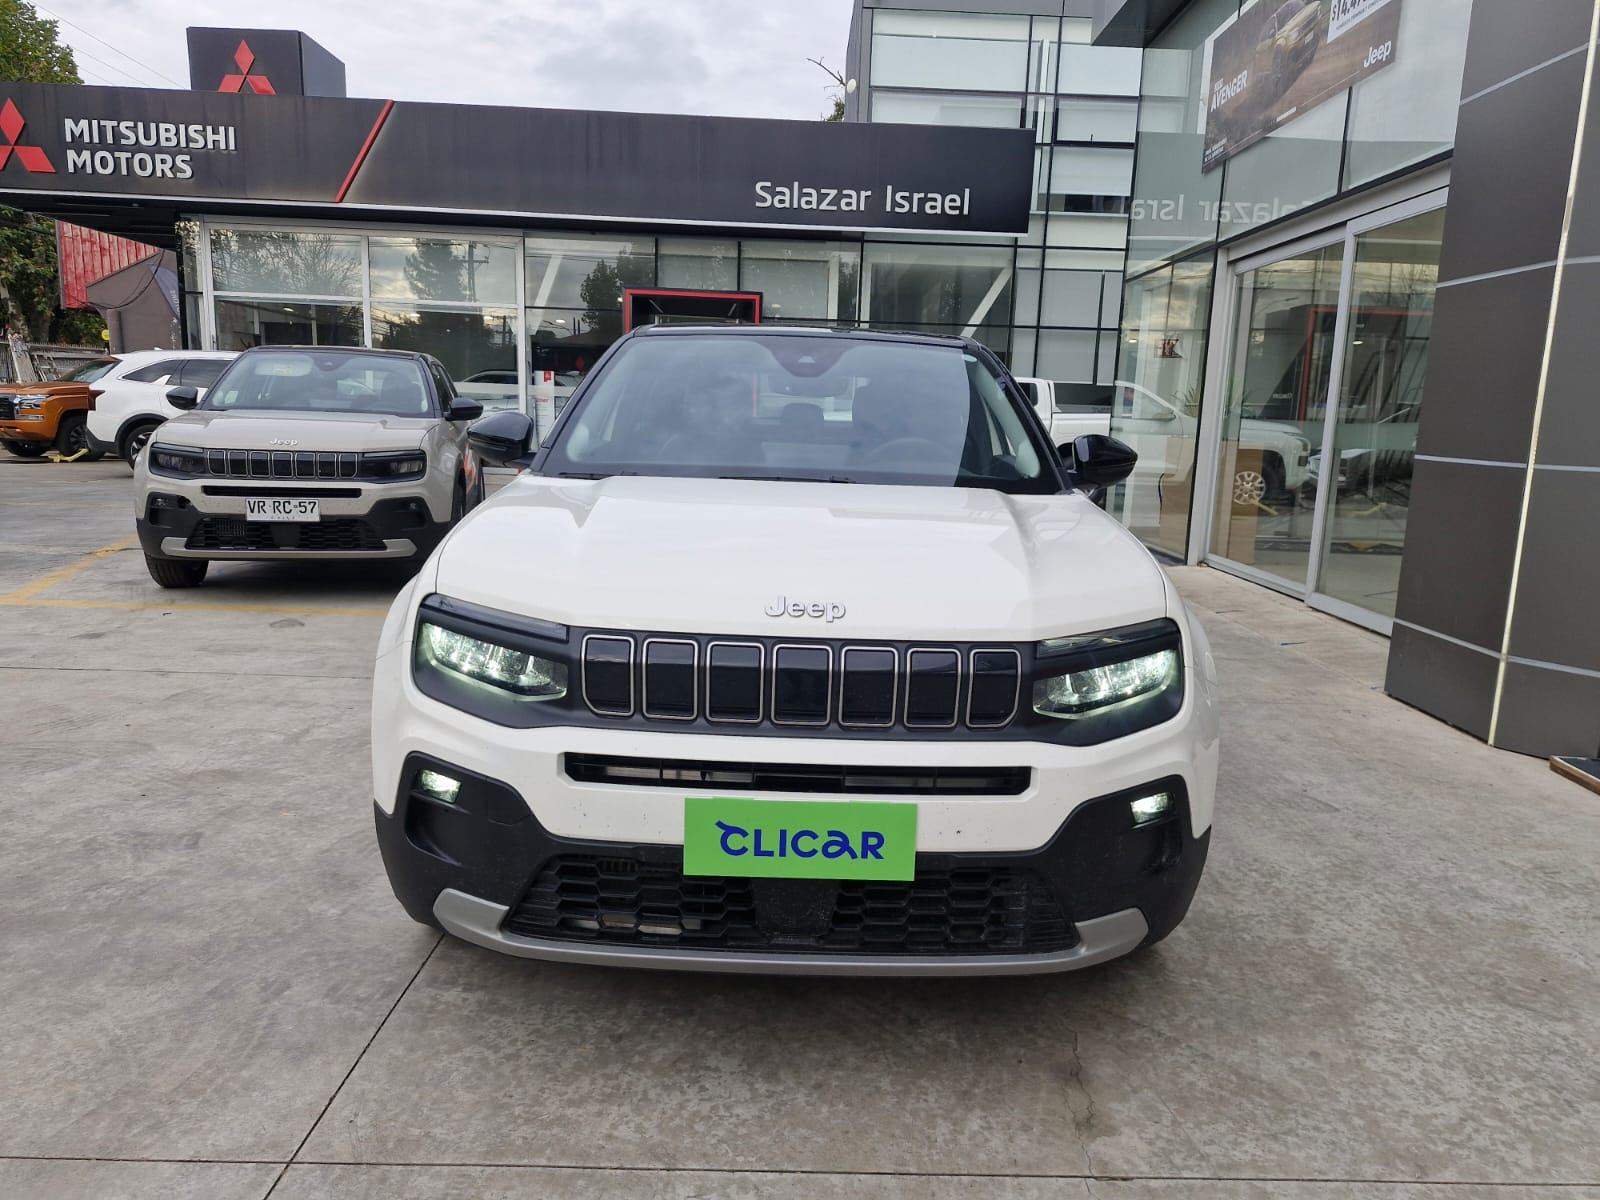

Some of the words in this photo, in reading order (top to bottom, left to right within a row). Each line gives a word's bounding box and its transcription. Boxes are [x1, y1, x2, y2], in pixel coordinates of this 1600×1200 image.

[1363, 40, 1392, 68] Jeep
[1210, 69, 1248, 112] AVENGER
[63, 117, 236, 151] MITSUBISHI
[66, 149, 193, 179] MOTORS
[754, 181, 871, 212] Salazar
[886, 185, 970, 216] Israel
[270, 438, 298, 446] Jeep
[764, 596, 846, 622] Jeep
